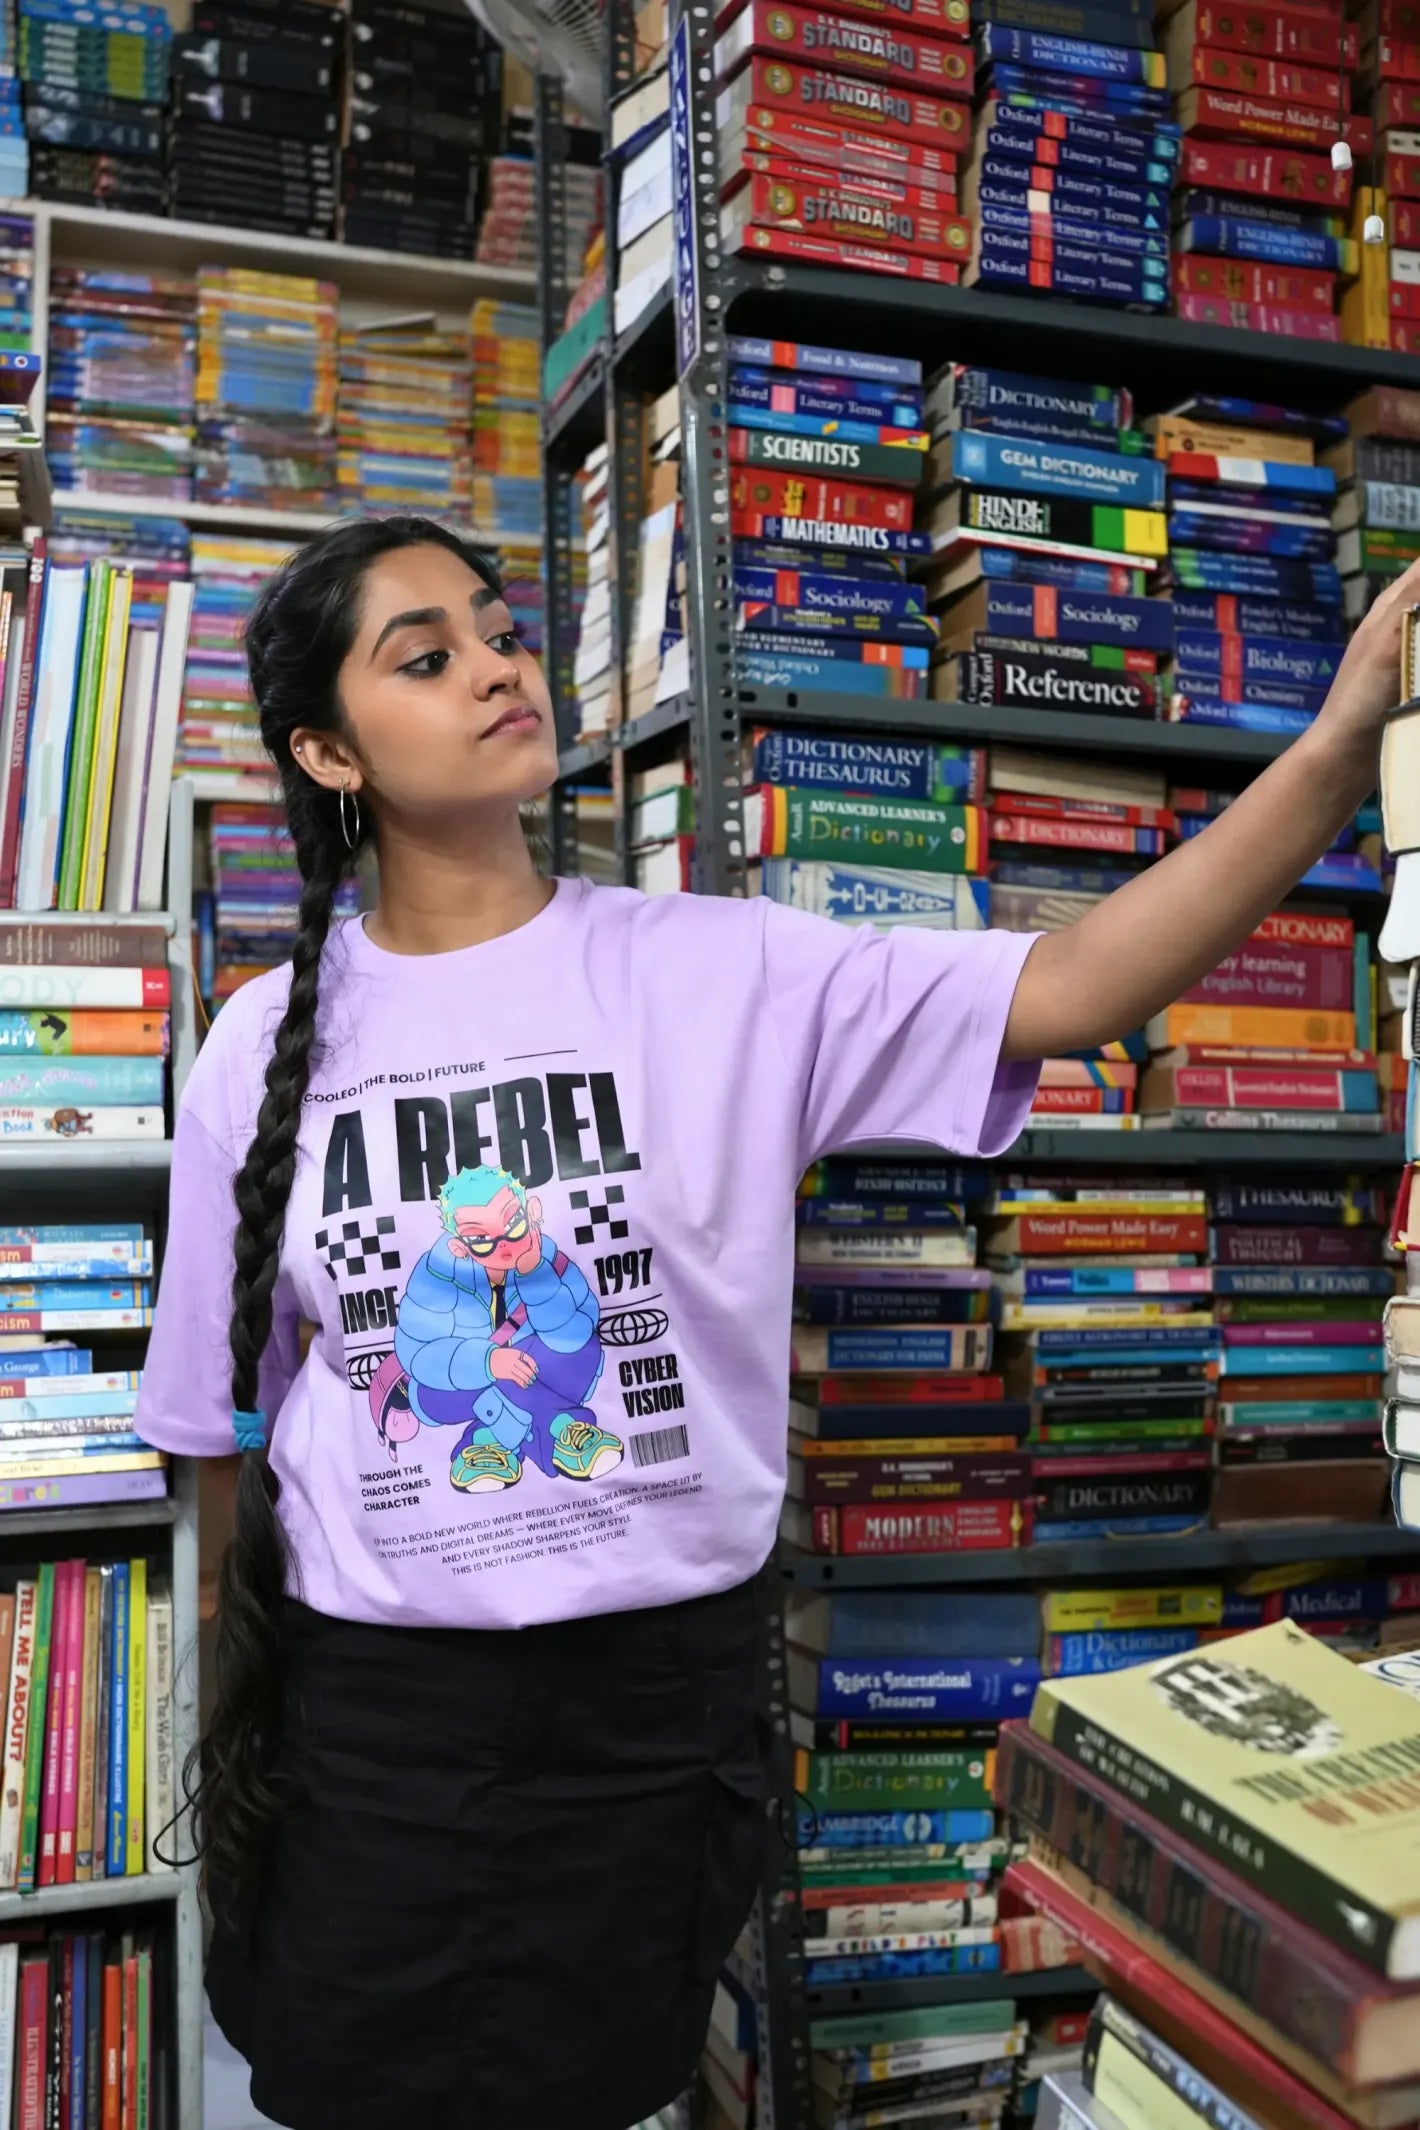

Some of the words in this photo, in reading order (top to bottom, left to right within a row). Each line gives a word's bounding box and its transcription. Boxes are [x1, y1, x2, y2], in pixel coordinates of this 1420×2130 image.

[803, 22, 915, 70] STANDARD
[1033, 50, 1129, 73] DICTIONARY
[801, 78, 911, 124] STANDARD
[1207, 94, 1243, 115] Word
[1244, 101, 1284, 122] Power
[1286, 109, 1319, 129] Made
[1322, 117, 1351, 136] Easy
[999, 106, 1041, 125] Oxford
[1070, 121, 1109, 142] Literary
[1114, 130, 1144, 148] Terms
[990, 132, 1034, 151] Oxford
[1063, 147, 1103, 168] Literary
[1107, 155, 1137, 173] Terms
[985, 162, 1030, 181] Oxford
[1057, 176, 1101, 197] Literary
[1107, 184, 1142, 204] Terms
[803, 197, 914, 243] STANDARD
[981, 187, 1026, 205] Oxford
[1054, 201, 1100, 222] Literary
[1105, 208, 1140, 226] Terms
[984, 210, 1028, 229] Oxford
[1056, 221, 1101, 243] Literary
[1106, 229, 1140, 246] Terms
[983, 233, 1028, 251] Oxford
[1057, 244, 1098, 264] Literary
[1101, 251, 1134, 268] Terms
[982, 259, 1026, 277] Oxford
[1055, 269, 1097, 289] Literary
[1100, 276, 1133, 294] Terms
[802, 350, 832, 365] Food
[800, 394, 845, 414] Literary
[848, 402, 883, 418] Terms
[990, 385, 1099, 417] DICTIONARY
[762, 435, 860, 468] SCIENTISTS
[1000, 448, 1038, 469] GEM
[1041, 455, 1139, 486] DICTIONARY
[782, 517, 890, 550] MATHEMATICS
[978, 513, 1044, 534] ENGLISH
[30, 557, 44, 584] 100
[805, 587, 894, 613] Sociology
[989, 600, 1033, 616] Oxford
[1062, 604, 1141, 632] Sociology
[1173, 603, 1214, 619] Oxford
[1179, 643, 1219, 660] Oxford
[1247, 648, 1317, 679] Biology
[979, 652, 994, 708] Oxford
[1004, 663, 1141, 708] Reference
[1179, 678, 1219, 695] Oxford
[1246, 686, 1306, 705] Chemistry
[787, 737, 924, 766] DICTIONARY
[785, 759, 911, 788] THESAURUS
[810, 800, 879, 818] ADVANCED
[881, 805, 947, 824] LEARNER'S
[809, 815, 940, 856] Dictionary
[1030, 824, 1126, 846] DICTIONARY
[1243, 953, 1306, 978] learning
[1202, 977, 1253, 995] English
[1258, 978, 1306, 998] Library
[304, 1087, 357, 1103] COOLEO
[363, 1074, 386, 1090] THE
[389, 1071, 425, 1084] BOLD
[434, 1061, 485, 1078] FUTURE
[1206, 1110, 1258, 1129] Collins
[1262, 1112, 1337, 1130] Thesaurus
[322, 1109, 373, 1218] A
[394, 1071, 642, 1203] REBEL
[1028, 1220, 1066, 1236] Word
[1068, 1221, 1110, 1236] Power
[1111, 1220, 1148, 1235] Made
[1149, 1220, 1179, 1239] Easy
[594, 1247, 653, 1297] 1997
[339, 1285, 400, 1334] INCE
[4, 1360, 40, 1374] George
[618, 1353, 679, 1388] CYBER
[622, 1382, 685, 1418] VISION
[359, 1468, 402, 1483] THROUGH
[402, 1464, 424, 1477] THE
[361, 1486, 391, 1498] CHAOS
[392, 1478, 431, 1494] COMES
[364, 1496, 420, 1512] CHARACTER
[381, 1537, 399, 1547] INTO
[401, 1535, 408, 1544] A
[409, 1531, 433, 1544] BOLD
[434, 1526, 456, 1539] NEW
[457, 1519, 491, 1534] WORLD
[492, 1512, 524, 1527] WHERE
[525, 1502, 571, 1519] REBELLION
[572, 1497, 598, 1511] FUELS
[642, 1484, 648, 1492] A
[650, 1478, 679, 1492] SPACE
[680, 1475, 690, 1486] LIT
[692, 1471, 703, 1482] BY
[1068, 1484, 1193, 1508] DICTIONARY
[387, 1547, 418, 1560] TRUTHS
[420, 1543, 439, 1555] AND
[441, 1537, 475, 1552] DIGITAL
[477, 1527, 514, 1544] DREAMS
[526, 1519, 559, 1533] WHERE
[560, 1513, 586, 1530] EVERY
[588, 1506, 614, 1520] MOVE
[615, 1497, 643, 1513] DEFINES
[644, 1491, 669, 1504] YOUR
[669, 1485, 703, 1499] LEGEND
[865, 1514, 956, 1539] MODERN
[442, 1553, 461, 1565] AND
[463, 1547, 490, 1561] EVERY
[492, 1538, 534, 1554] SHADOW
[535, 1527, 582, 1544] SHARPENS
[583, 1520, 607, 1534] YOUR
[608, 1513, 632, 1528] STYLE
[451, 1564, 472, 1577] THIS
[473, 1562, 482, 1572] IS
[484, 1559, 503, 1570] NOT
[548, 1543, 568, 1556] THIS
[569, 1542, 578, 1552] IS
[580, 1537, 595, 1550] THE
[17, 1586, 35, 1630] TELL
[1288, 1591, 1362, 1616] Medical
[14, 1636, 32, 1667] ME
[1087, 1632, 1187, 1654] Dictionary
[884, 1670, 972, 1691] International
[867, 1691, 936, 1711] Thesaurus
[10, 1678, 28, 1763] ABOUT?
[833, 1754, 898, 1767] ADVANCED
[901, 1753, 965, 1767] LEARNER'S
[833, 1767, 960, 1796] Dictionary
[799, 1814, 898, 1834] CAMBRIDGE
